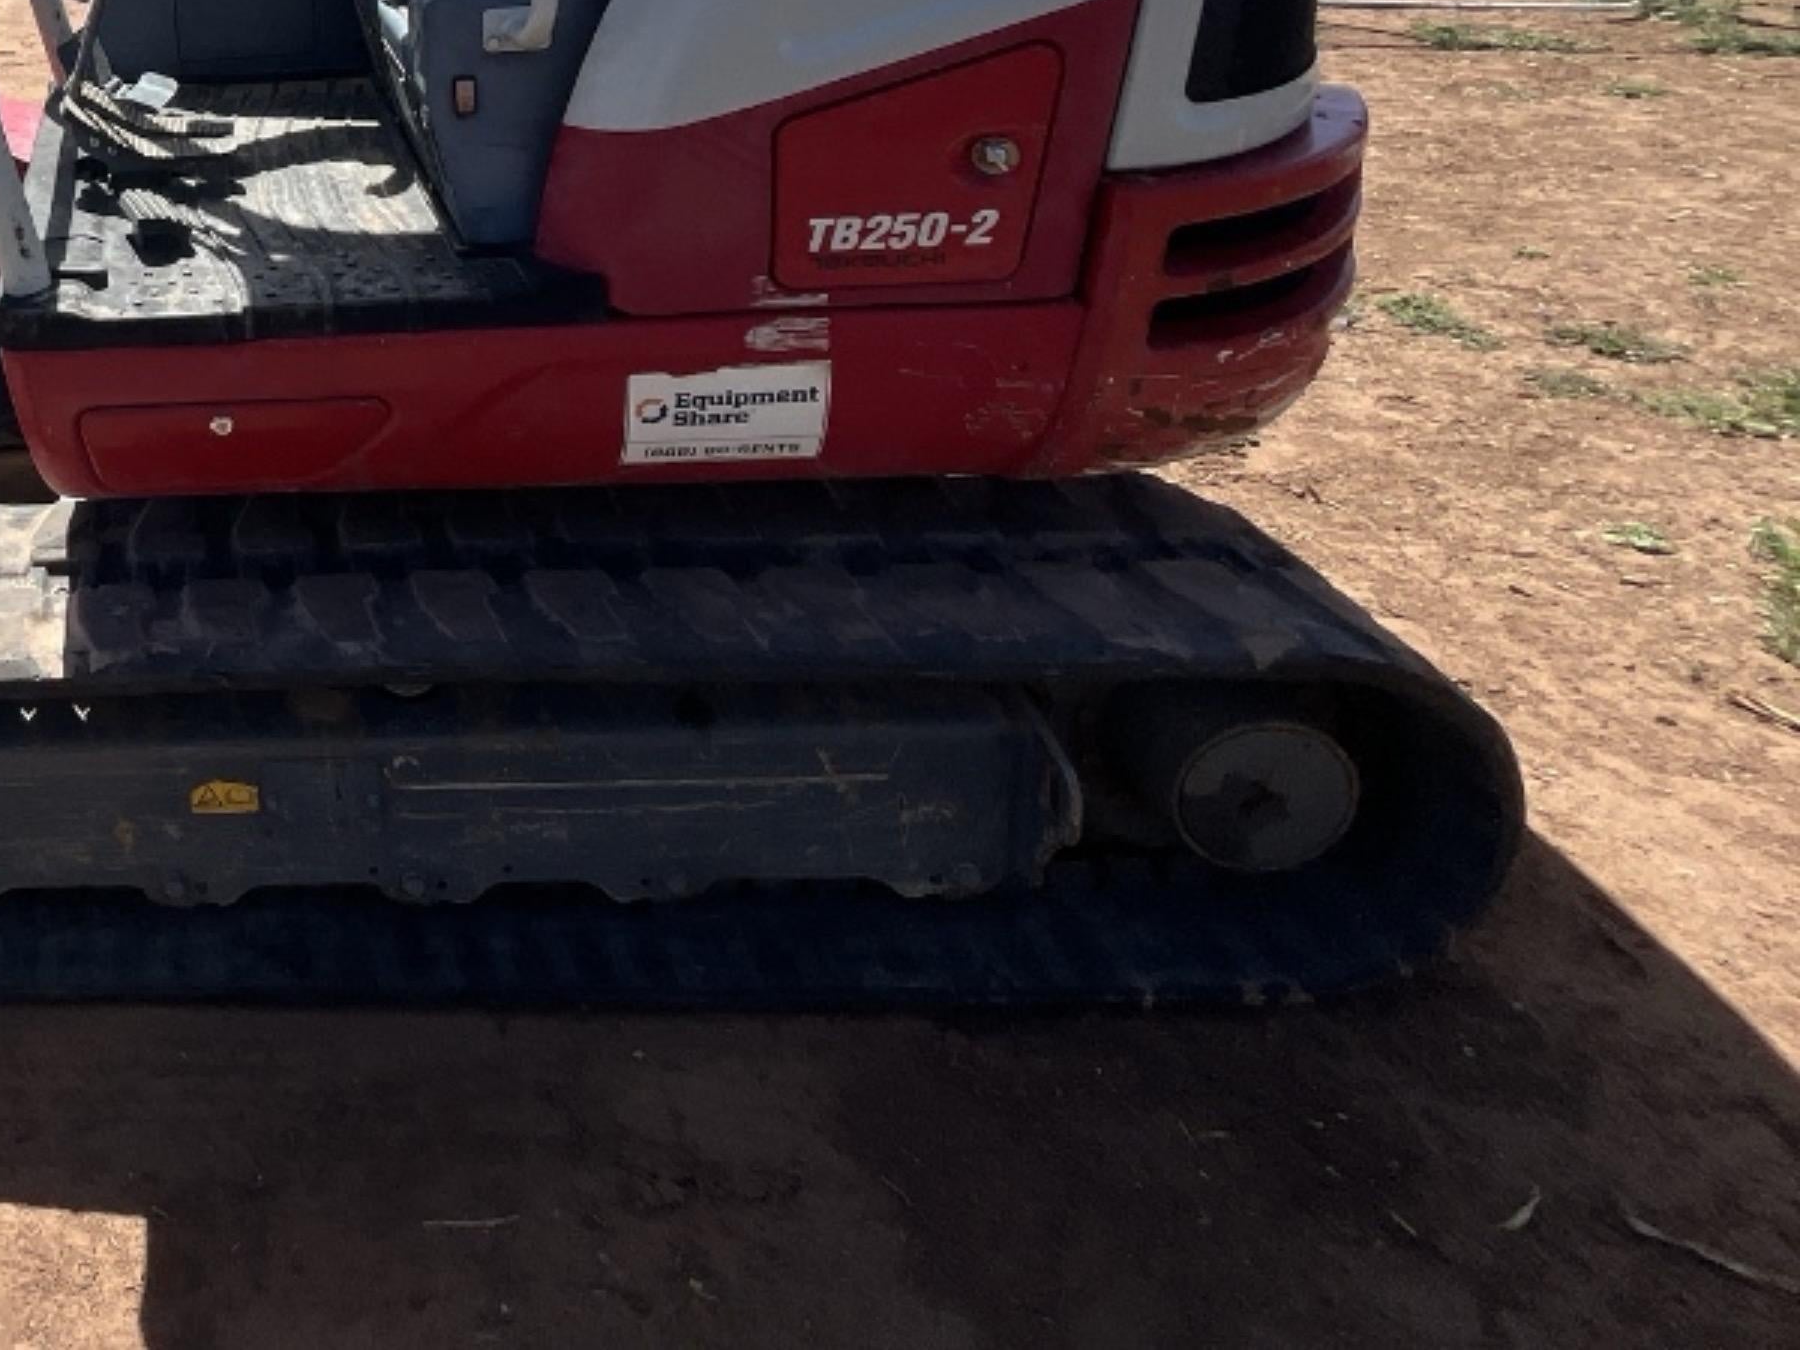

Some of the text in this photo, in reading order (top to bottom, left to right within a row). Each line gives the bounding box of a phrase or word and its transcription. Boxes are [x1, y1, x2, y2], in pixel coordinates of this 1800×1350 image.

[807, 209, 1000, 252] TB250-2
[674, 386, 820, 411] Equipment
[673, 411, 750, 427] Share
